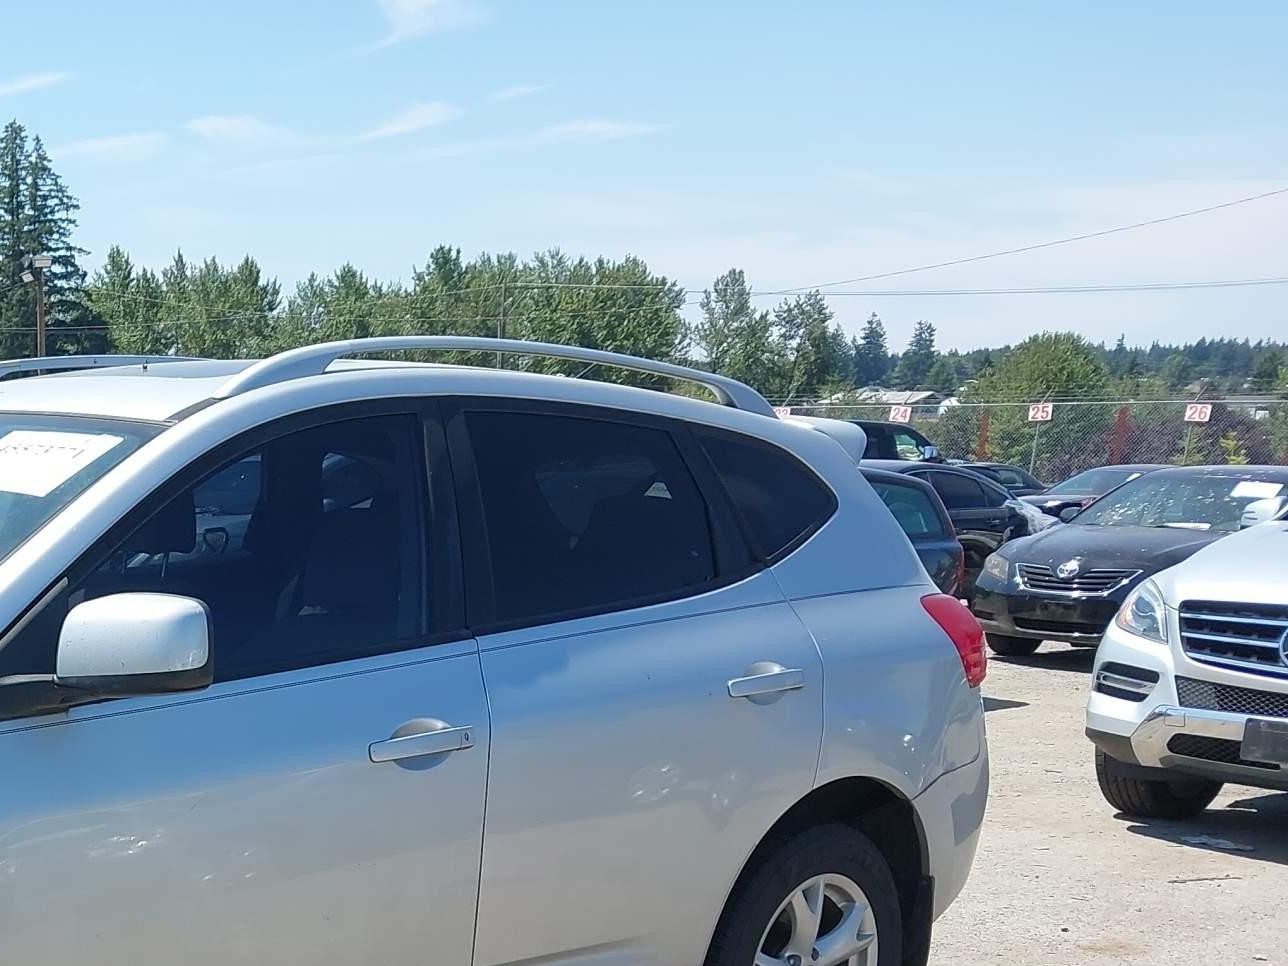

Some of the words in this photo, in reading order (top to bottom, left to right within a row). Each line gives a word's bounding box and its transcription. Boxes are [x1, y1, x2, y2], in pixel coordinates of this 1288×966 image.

[891, 408, 908, 421] 24
[1030, 405, 1049, 420] 25
[1188, 405, 1209, 420] 26
